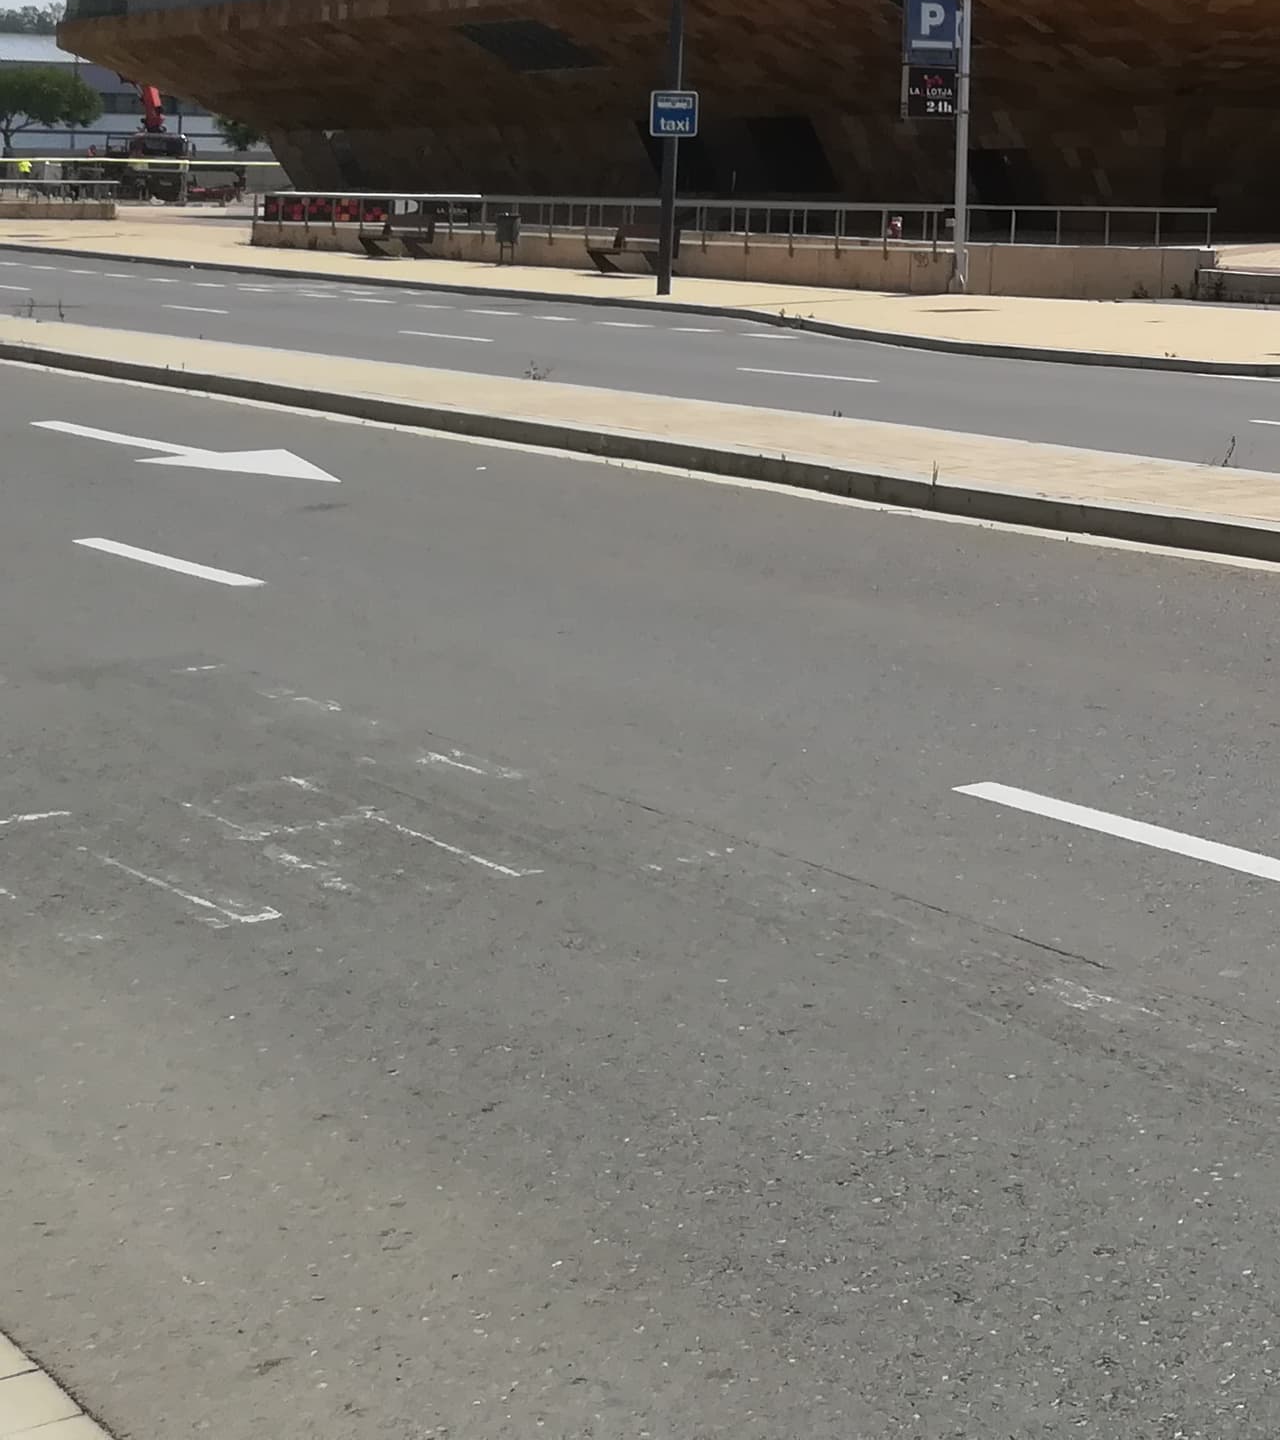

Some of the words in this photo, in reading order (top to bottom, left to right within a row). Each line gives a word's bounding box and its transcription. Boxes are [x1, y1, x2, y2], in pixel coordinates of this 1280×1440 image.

[921, 2, 945, 35] P
[909, 87, 920, 96] LA
[926, 101, 952, 113] 24h
[661, 116, 689, 132] taxi
